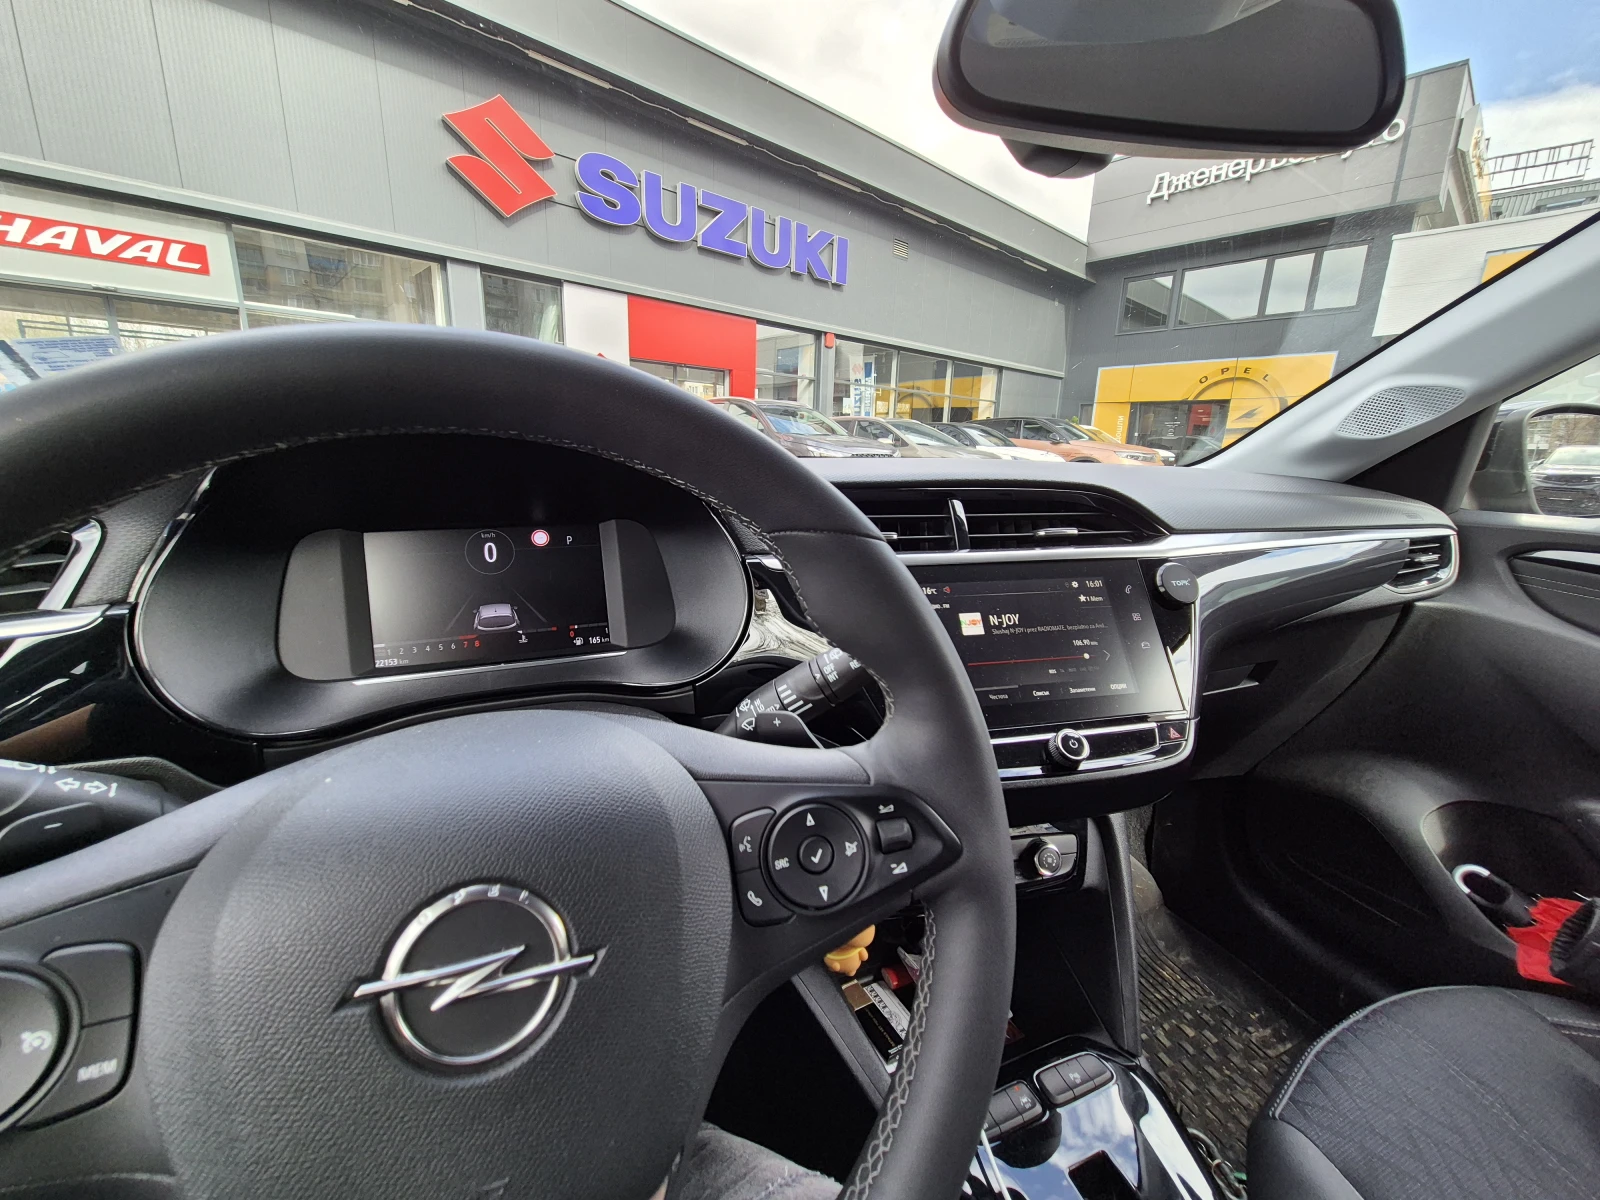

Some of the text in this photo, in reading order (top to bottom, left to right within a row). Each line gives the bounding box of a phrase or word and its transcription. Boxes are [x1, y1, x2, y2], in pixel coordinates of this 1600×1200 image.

[574, 151, 849, 286] SUZUKI
[0, 215, 202, 270] HAVAL
[1199, 367, 1270, 384] OPEL
[566, 535, 573, 545] P
[483, 542, 498, 563] 0
[1085, 580, 1103, 588] 16:01
[989, 613, 1020, 628] N-JOY
[1073, 638, 1091, 646] 106.90
[412, 646, 418, 654] 3
[375, 658, 398, 668] 22153
[823, 663, 835, 674] OFF
[827, 671, 839, 682] INT
[774, 857, 790, 871] SRC
